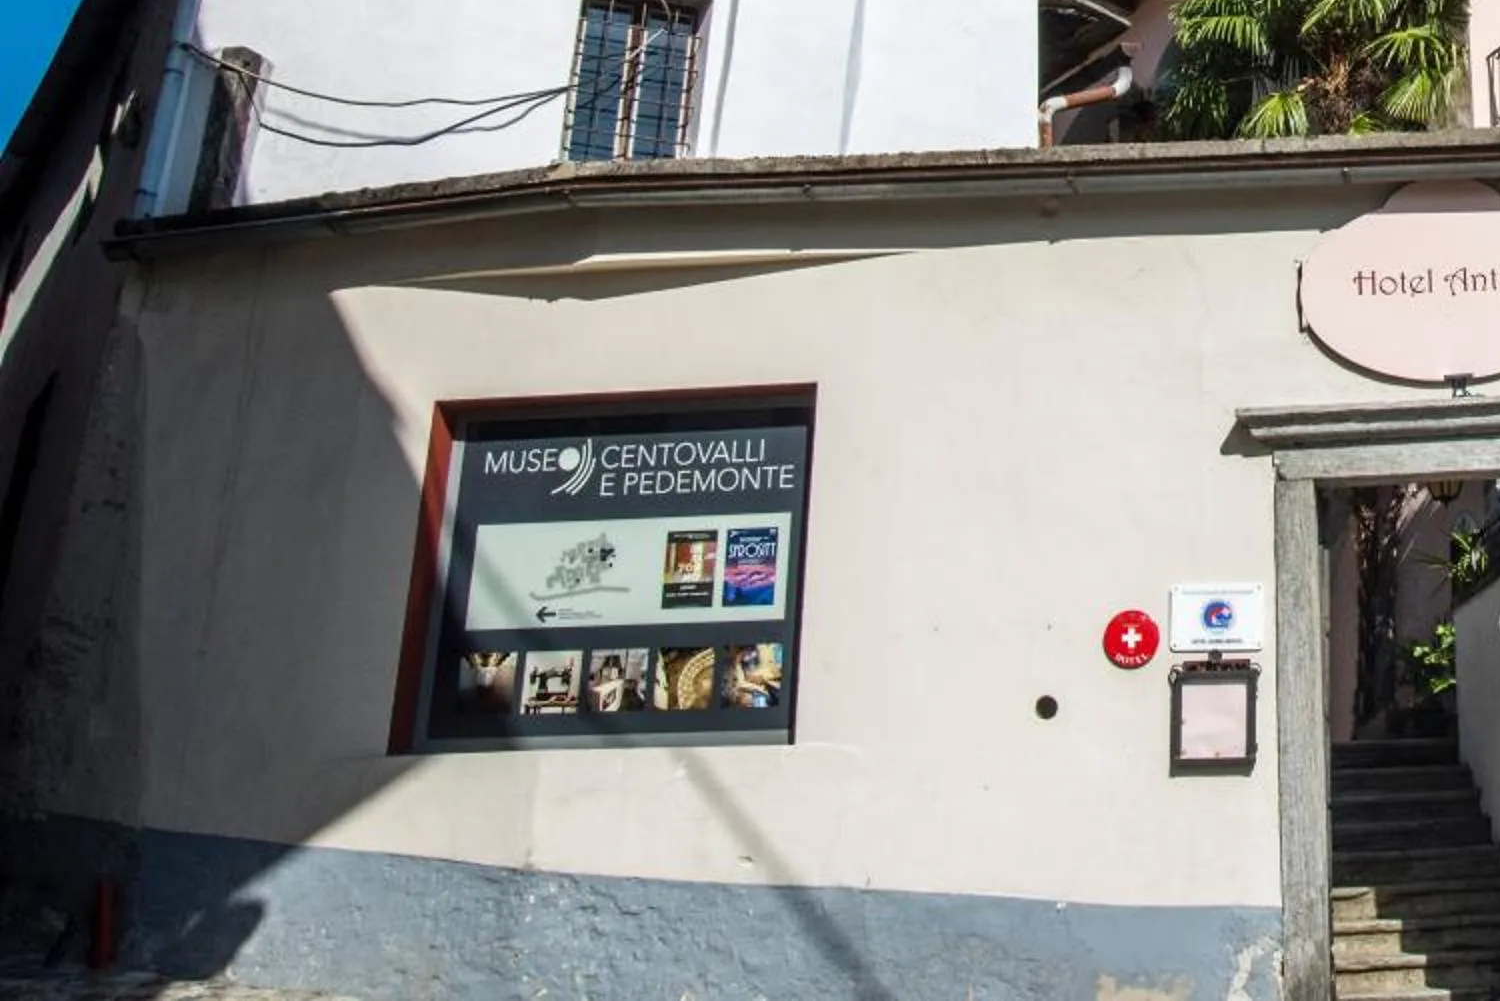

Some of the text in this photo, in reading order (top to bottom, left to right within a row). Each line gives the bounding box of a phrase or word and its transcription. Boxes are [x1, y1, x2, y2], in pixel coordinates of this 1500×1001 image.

[1353, 268, 1433, 297] Hotel
[484, 439, 766, 474] MUSEO CENTOVALLI
[600, 464, 795, 496] E PEDEMONTE
